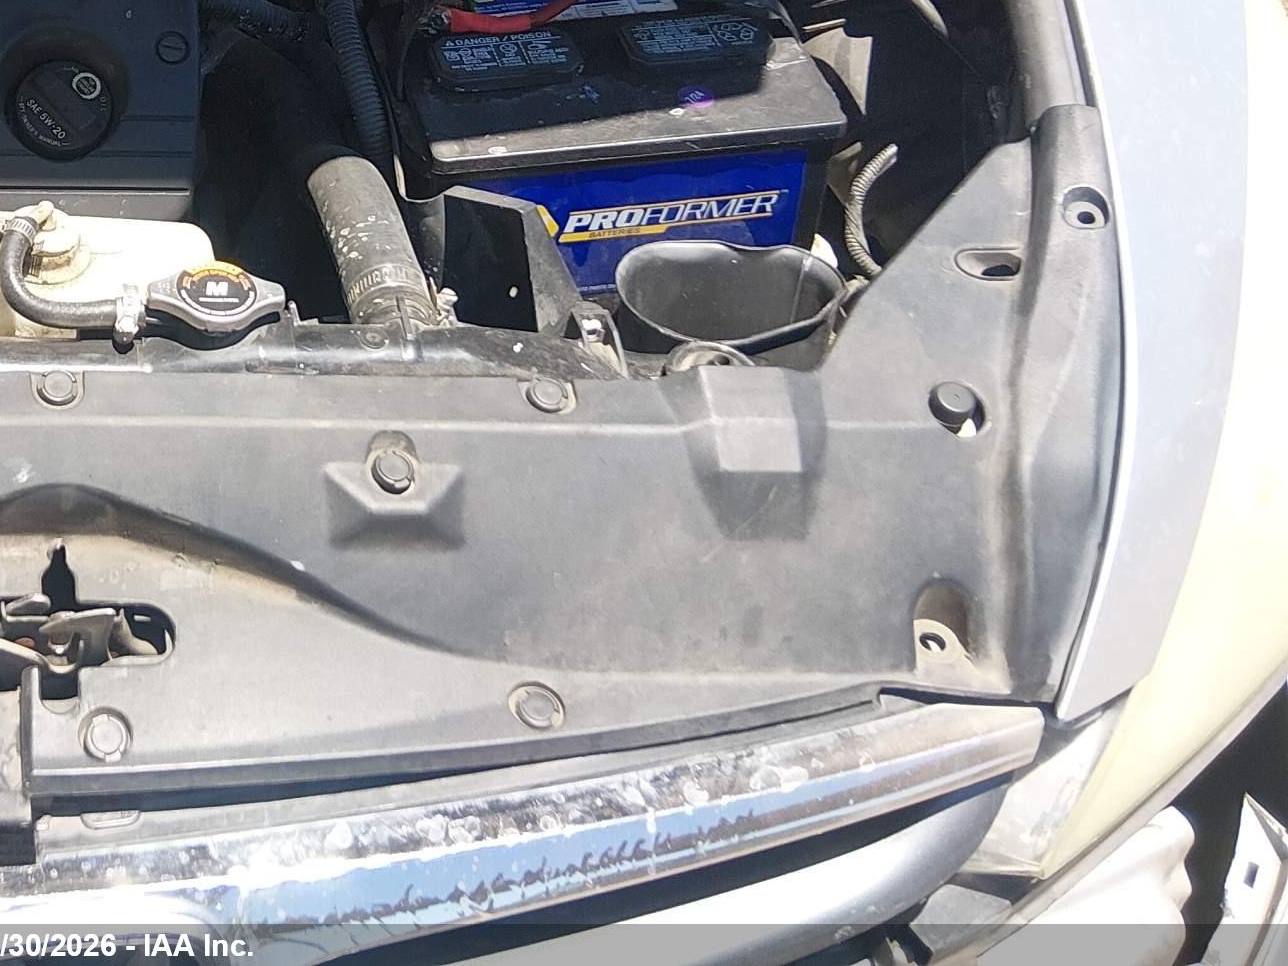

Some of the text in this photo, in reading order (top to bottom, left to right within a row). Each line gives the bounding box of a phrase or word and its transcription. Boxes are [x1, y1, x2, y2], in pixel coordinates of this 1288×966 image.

[455, 36, 500, 47] DANGER
[511, 31, 552, 42] POISON
[27, 99, 41, 115] SAE
[562, 193, 779, 233] PROFORMER
[589, 226, 642, 239] BATTERIES
[205, 280, 229, 297] M
